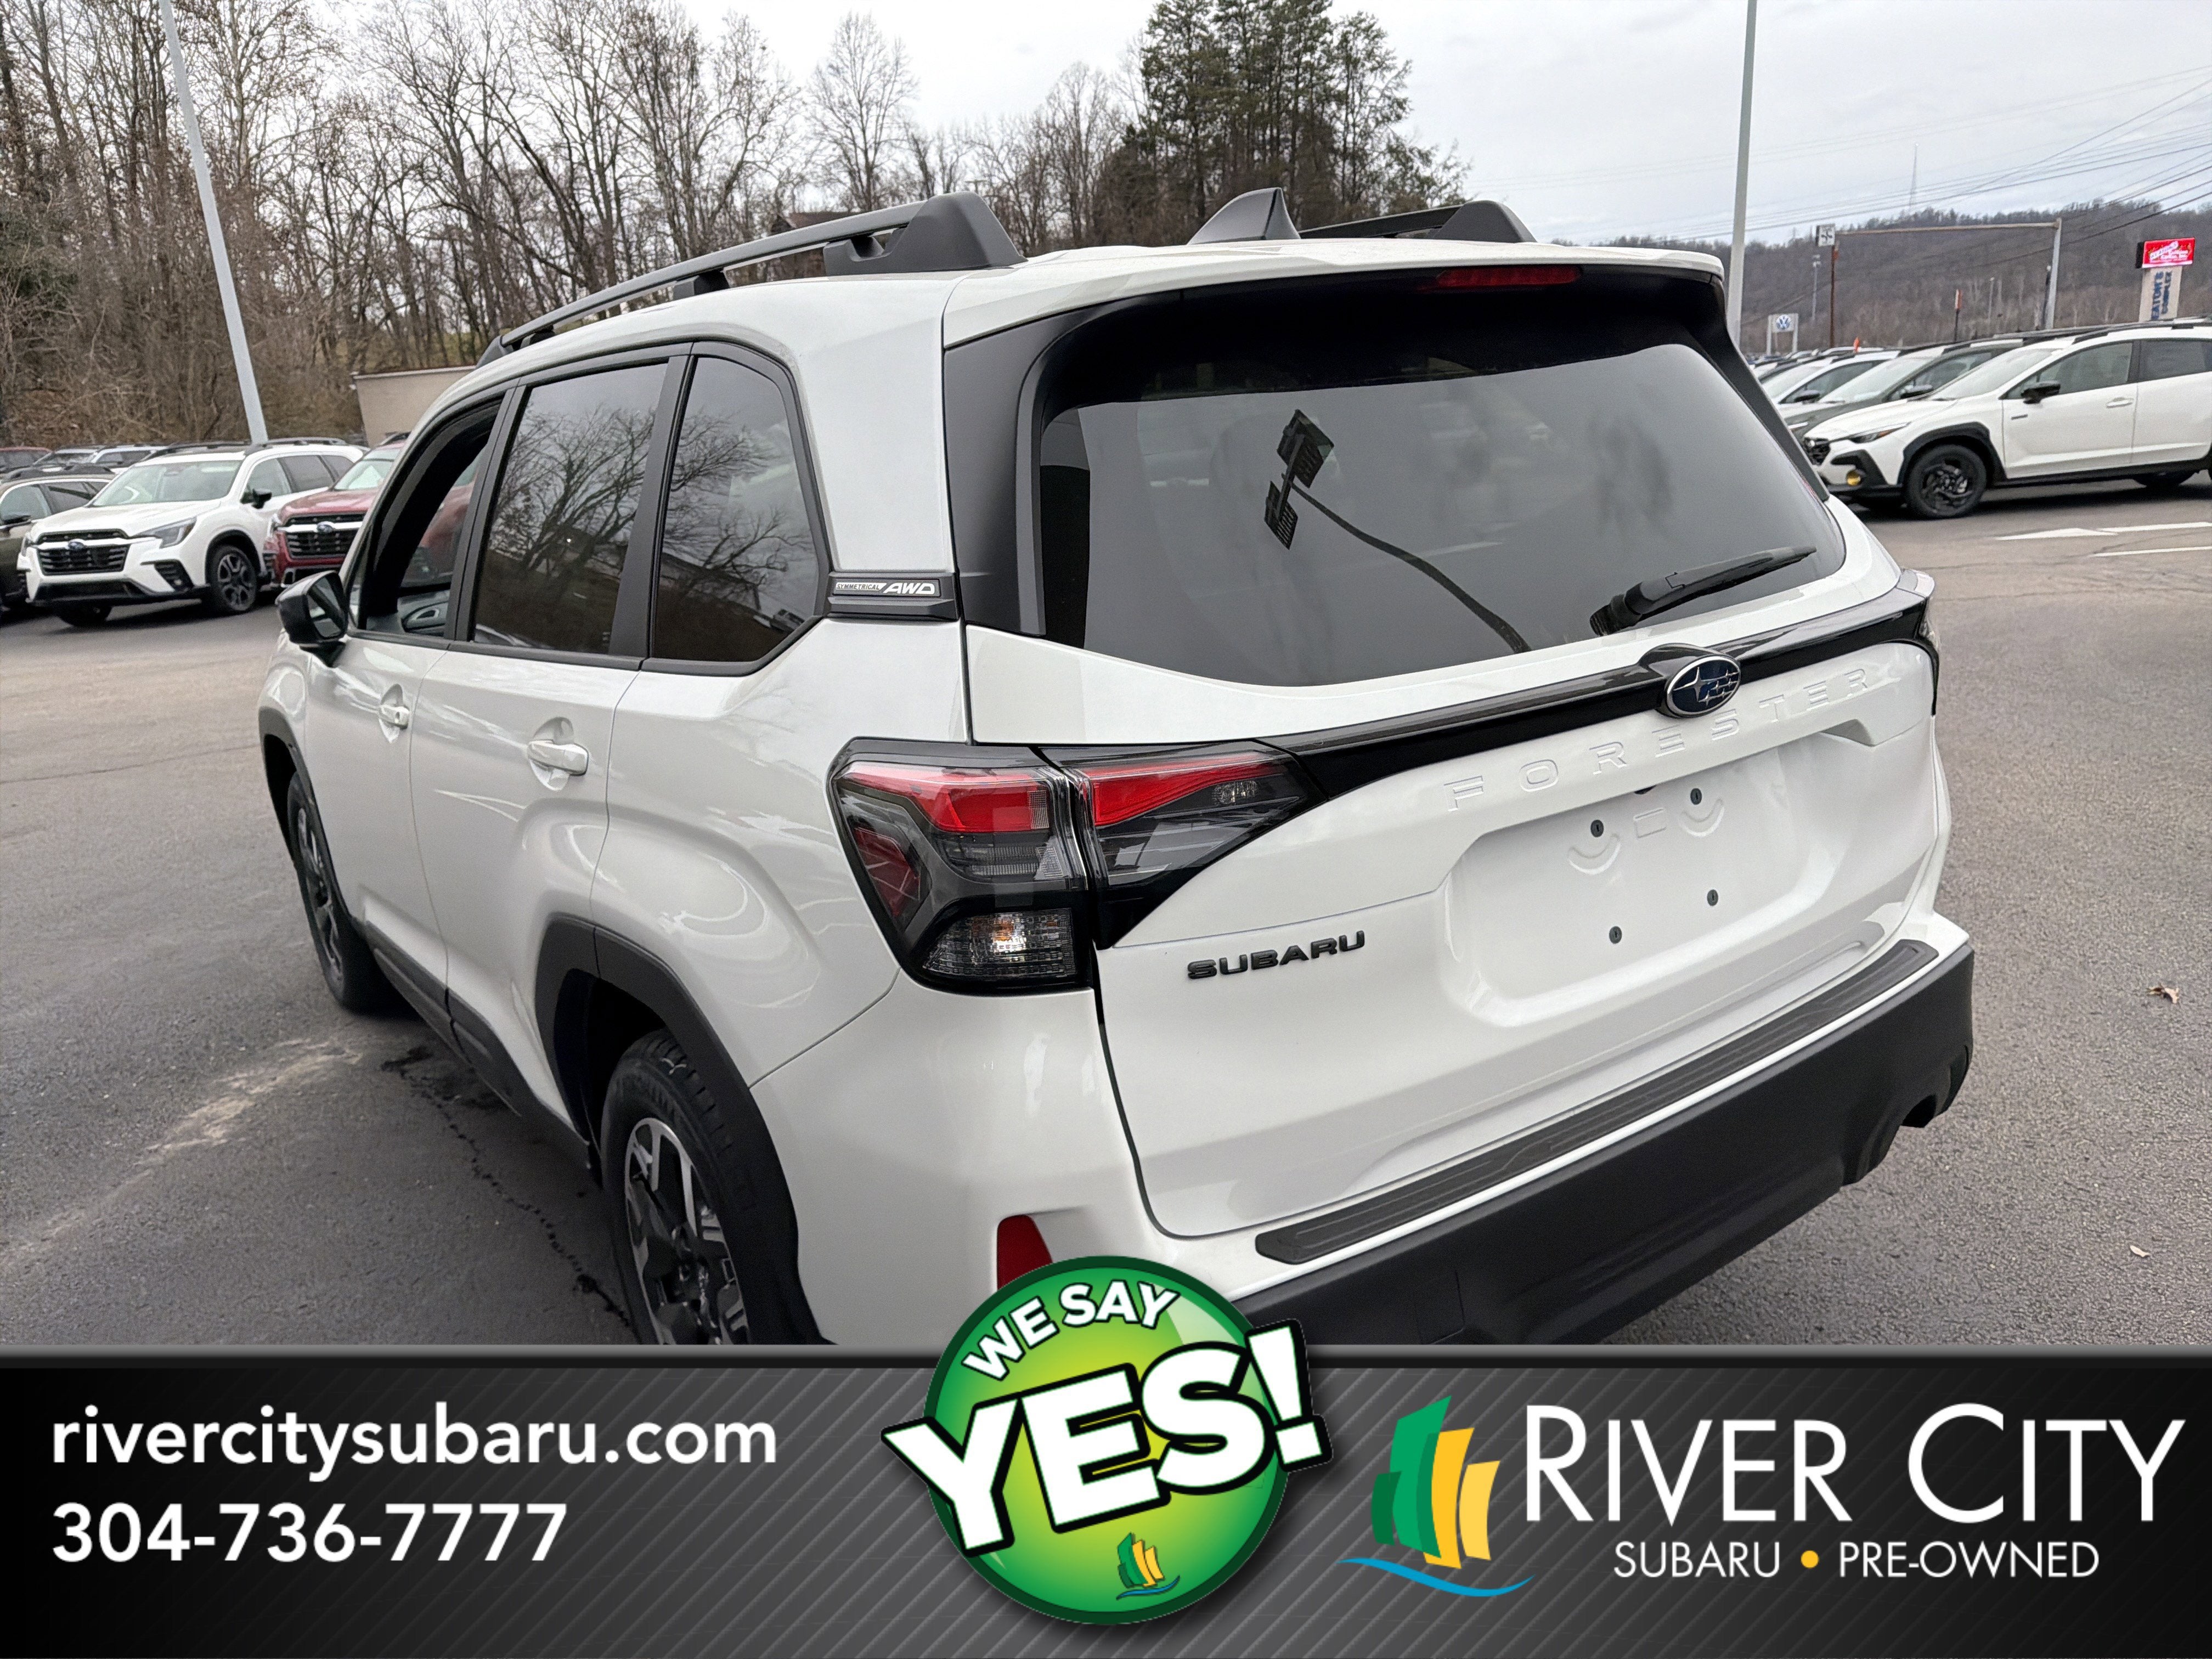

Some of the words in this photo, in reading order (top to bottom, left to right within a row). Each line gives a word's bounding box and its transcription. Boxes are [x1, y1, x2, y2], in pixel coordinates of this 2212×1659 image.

[836, 583, 879, 591] SYMMETRICAL
[883, 583, 935, 595] AWD
[1443, 668, 1868, 812] FORESTER
[1187, 930, 1365, 979] SUBARU
